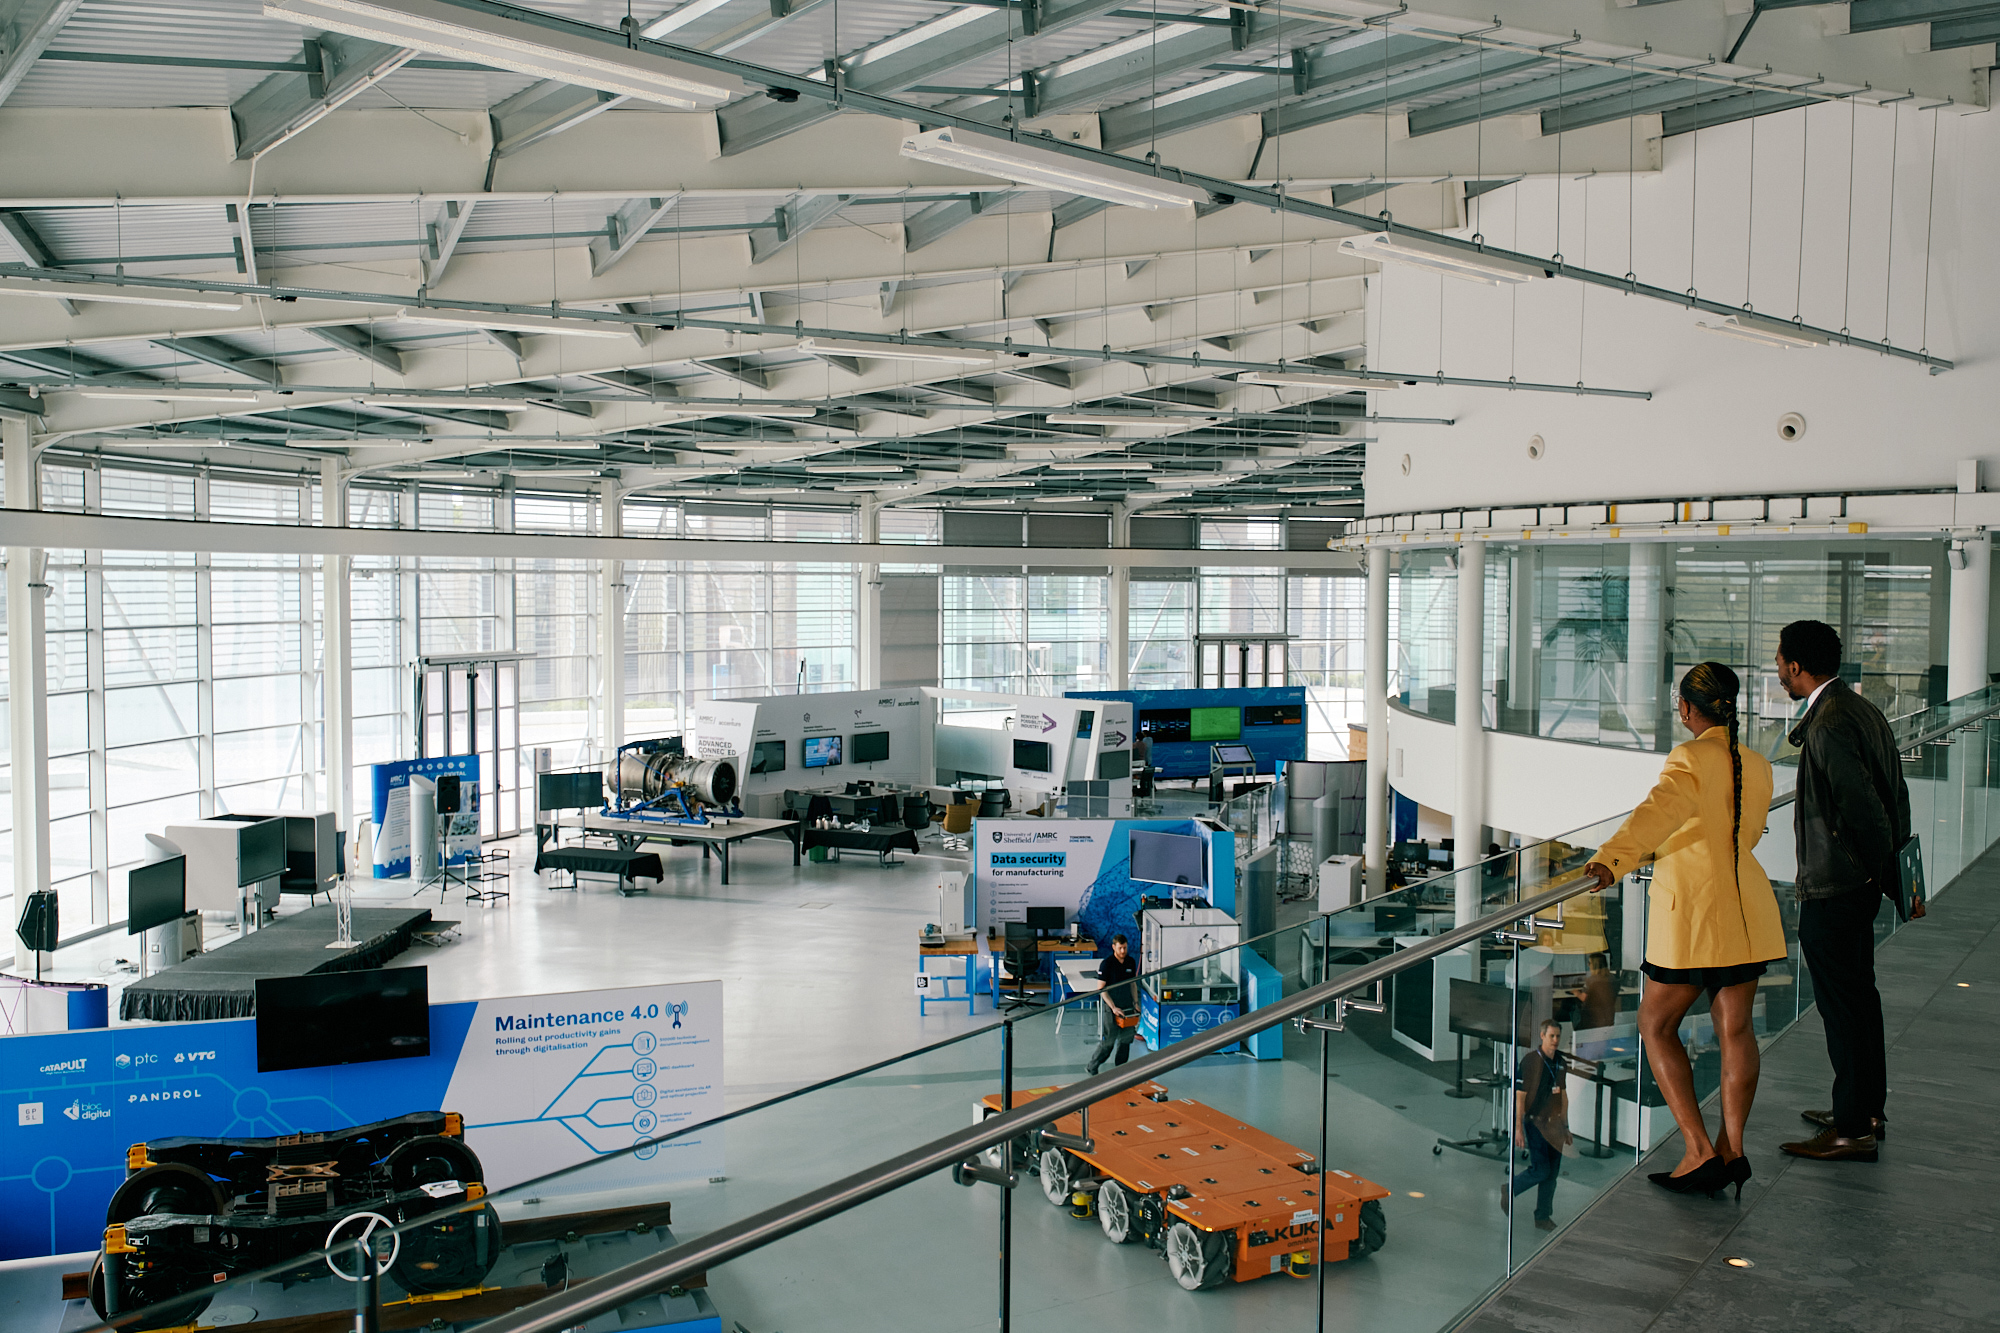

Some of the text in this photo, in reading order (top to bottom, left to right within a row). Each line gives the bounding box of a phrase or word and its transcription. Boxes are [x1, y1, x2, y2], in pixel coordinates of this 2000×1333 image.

[698, 740, 732, 748] ADVANCED
[698, 747, 736, 756] CONNECED
[992, 854, 1064, 865] Data security
[1006, 869, 1063, 877] manufacturing
[496, 1004, 659, 1031] Maintenance 4.0
[496, 1037, 526, 1045] Rolling
[544, 1030, 597, 1041] productivity
[600, 1028, 621, 1037] gains
[496, 1041, 588, 1056] through digitalisation
[135, 1053, 158, 1067] ptc
[188, 1051, 215, 1061] VTG
[40, 1059, 87, 1073] CATAPULT
[128, 1089, 201, 1103] PANDROL
[82, 1109, 111, 1120] digital
